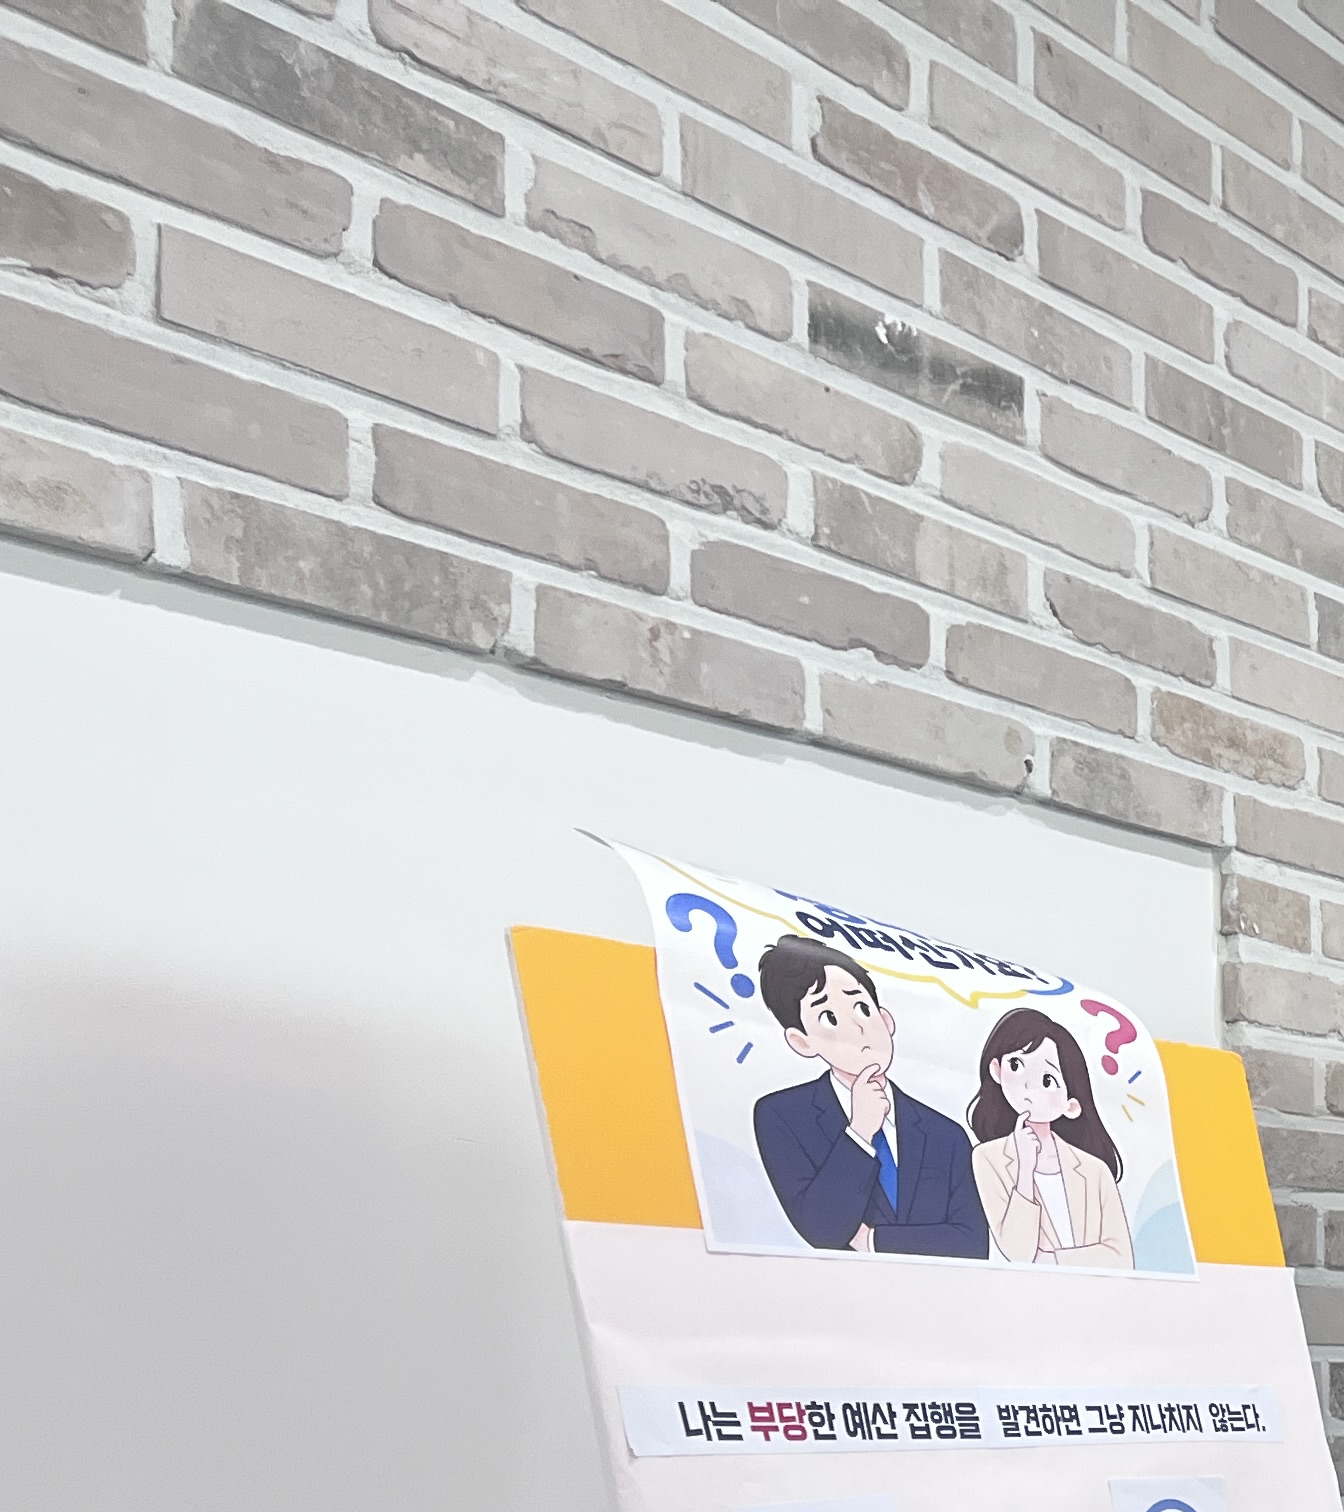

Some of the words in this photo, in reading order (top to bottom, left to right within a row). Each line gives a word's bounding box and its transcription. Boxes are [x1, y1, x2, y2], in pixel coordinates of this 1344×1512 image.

[677, 1400, 744, 1442] 나는
[747, 1400, 838, 1442] 부당한
[842, 1401, 899, 1441] 예산
[902, 1401, 982, 1440] 집행을
[996, 1403, 1083, 1437] 발견하면
[1085, 1403, 1126, 1434] 그냥
[1128, 1402, 1203, 1433] 지나치지
[1208, 1402, 1267, 1433] 않는다.
